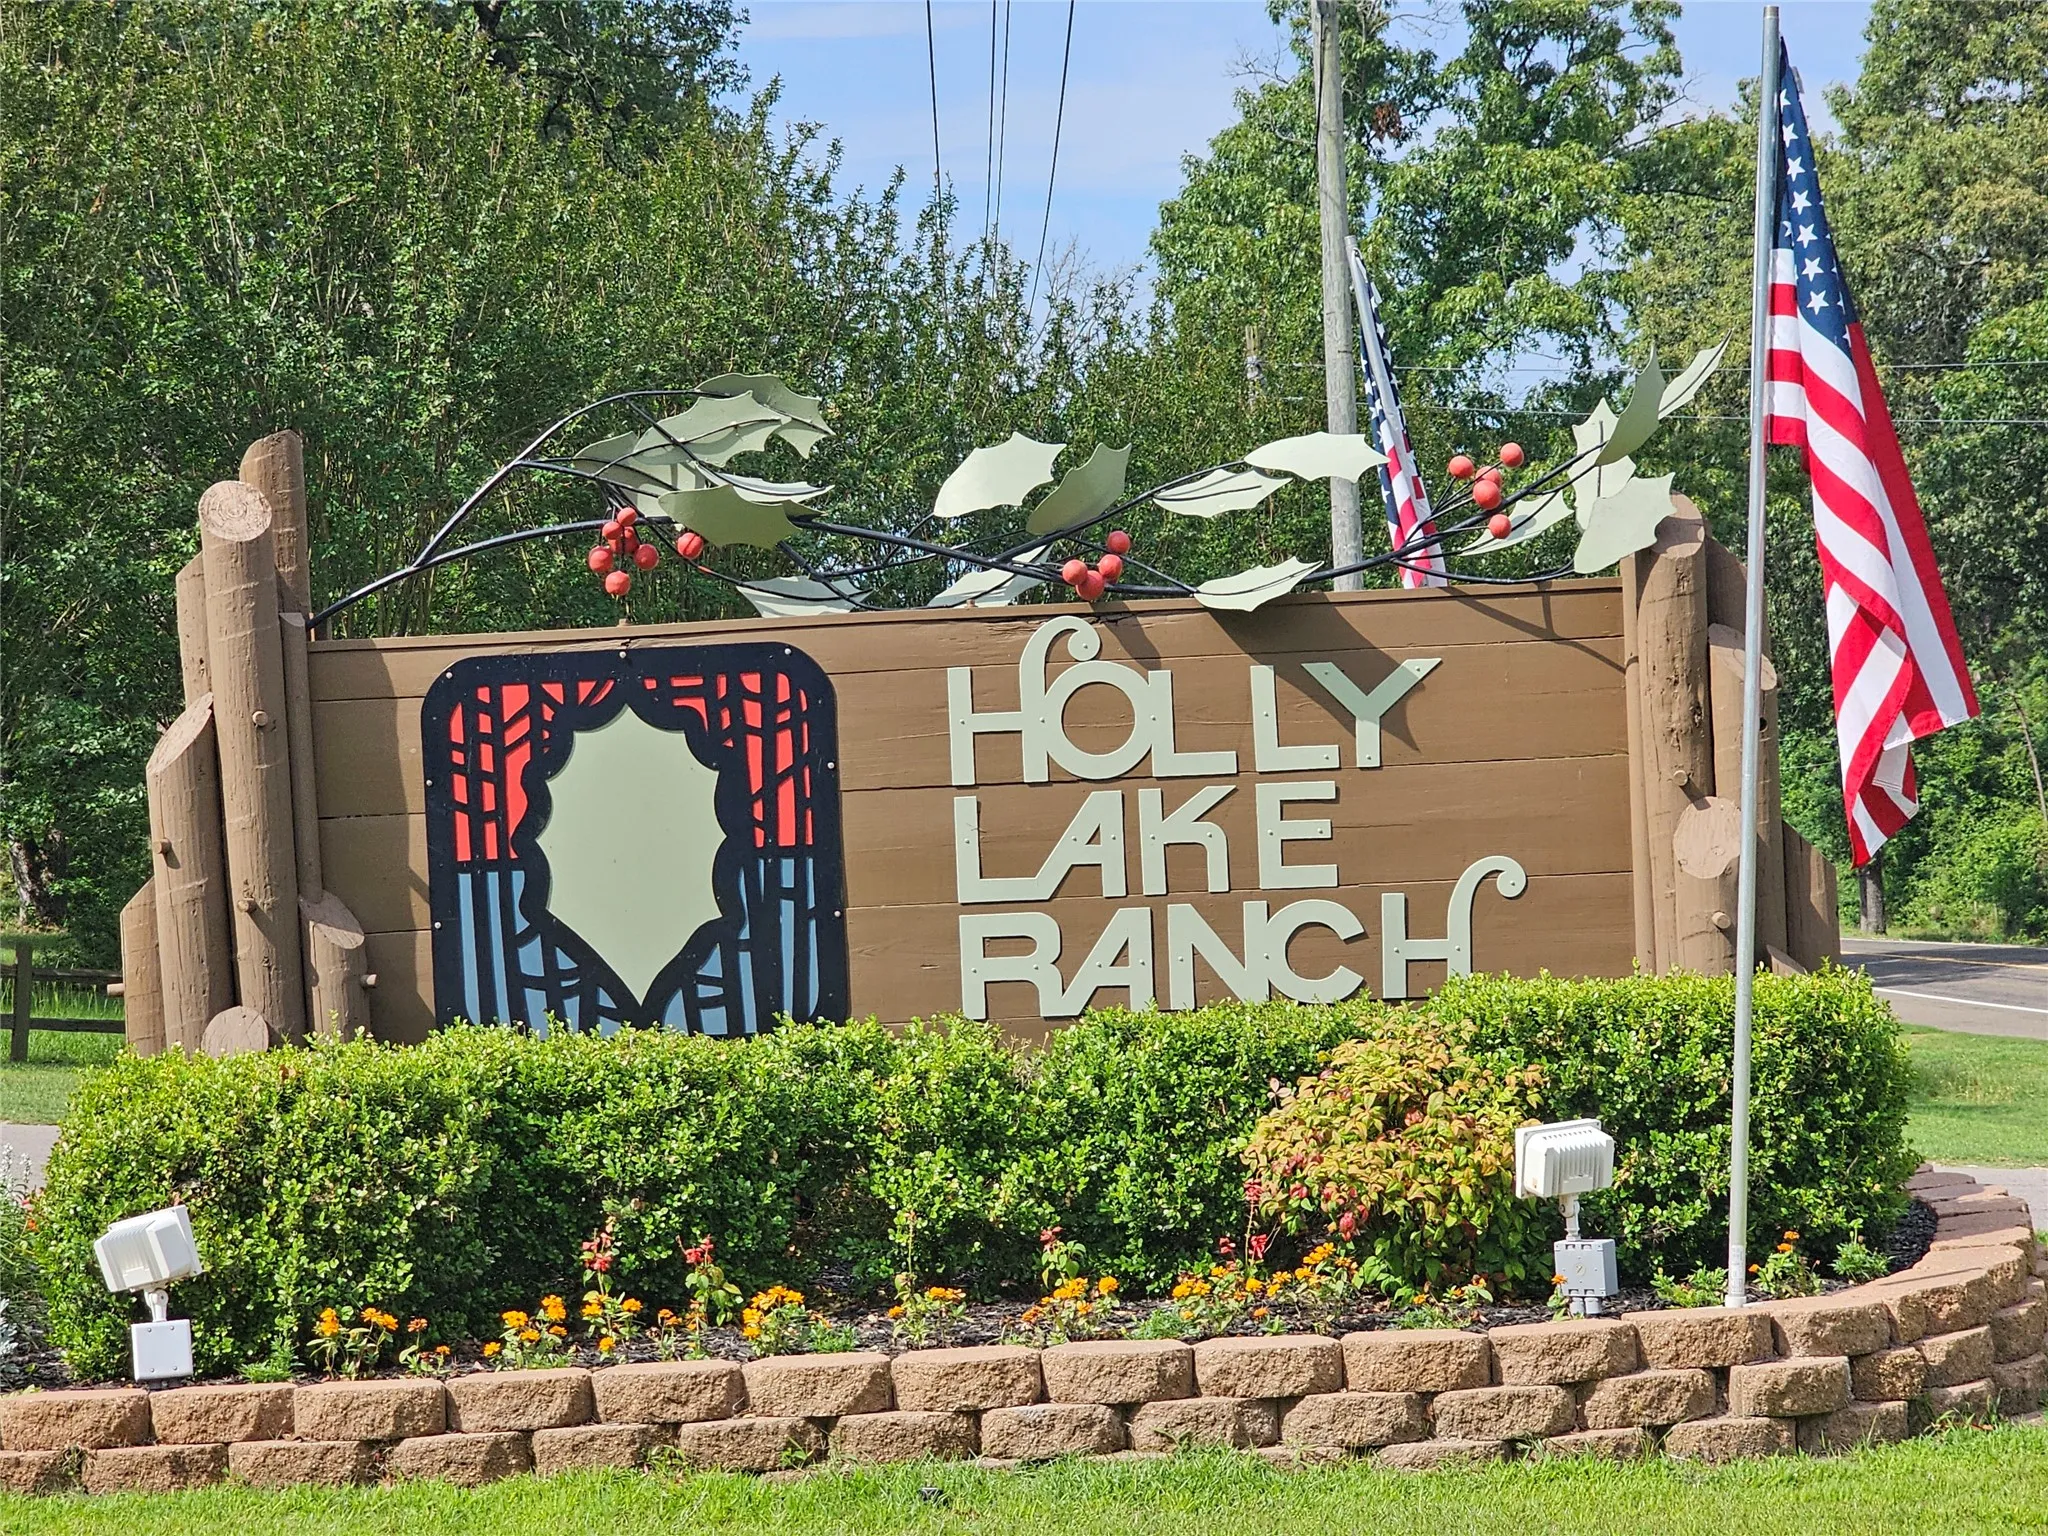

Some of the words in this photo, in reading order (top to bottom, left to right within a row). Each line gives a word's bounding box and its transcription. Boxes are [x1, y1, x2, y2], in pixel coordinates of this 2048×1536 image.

[947, 616, 1442, 786] HOLLY
[953, 780, 1340, 904] LAKE
[959, 856, 1527, 1020] RANCH
